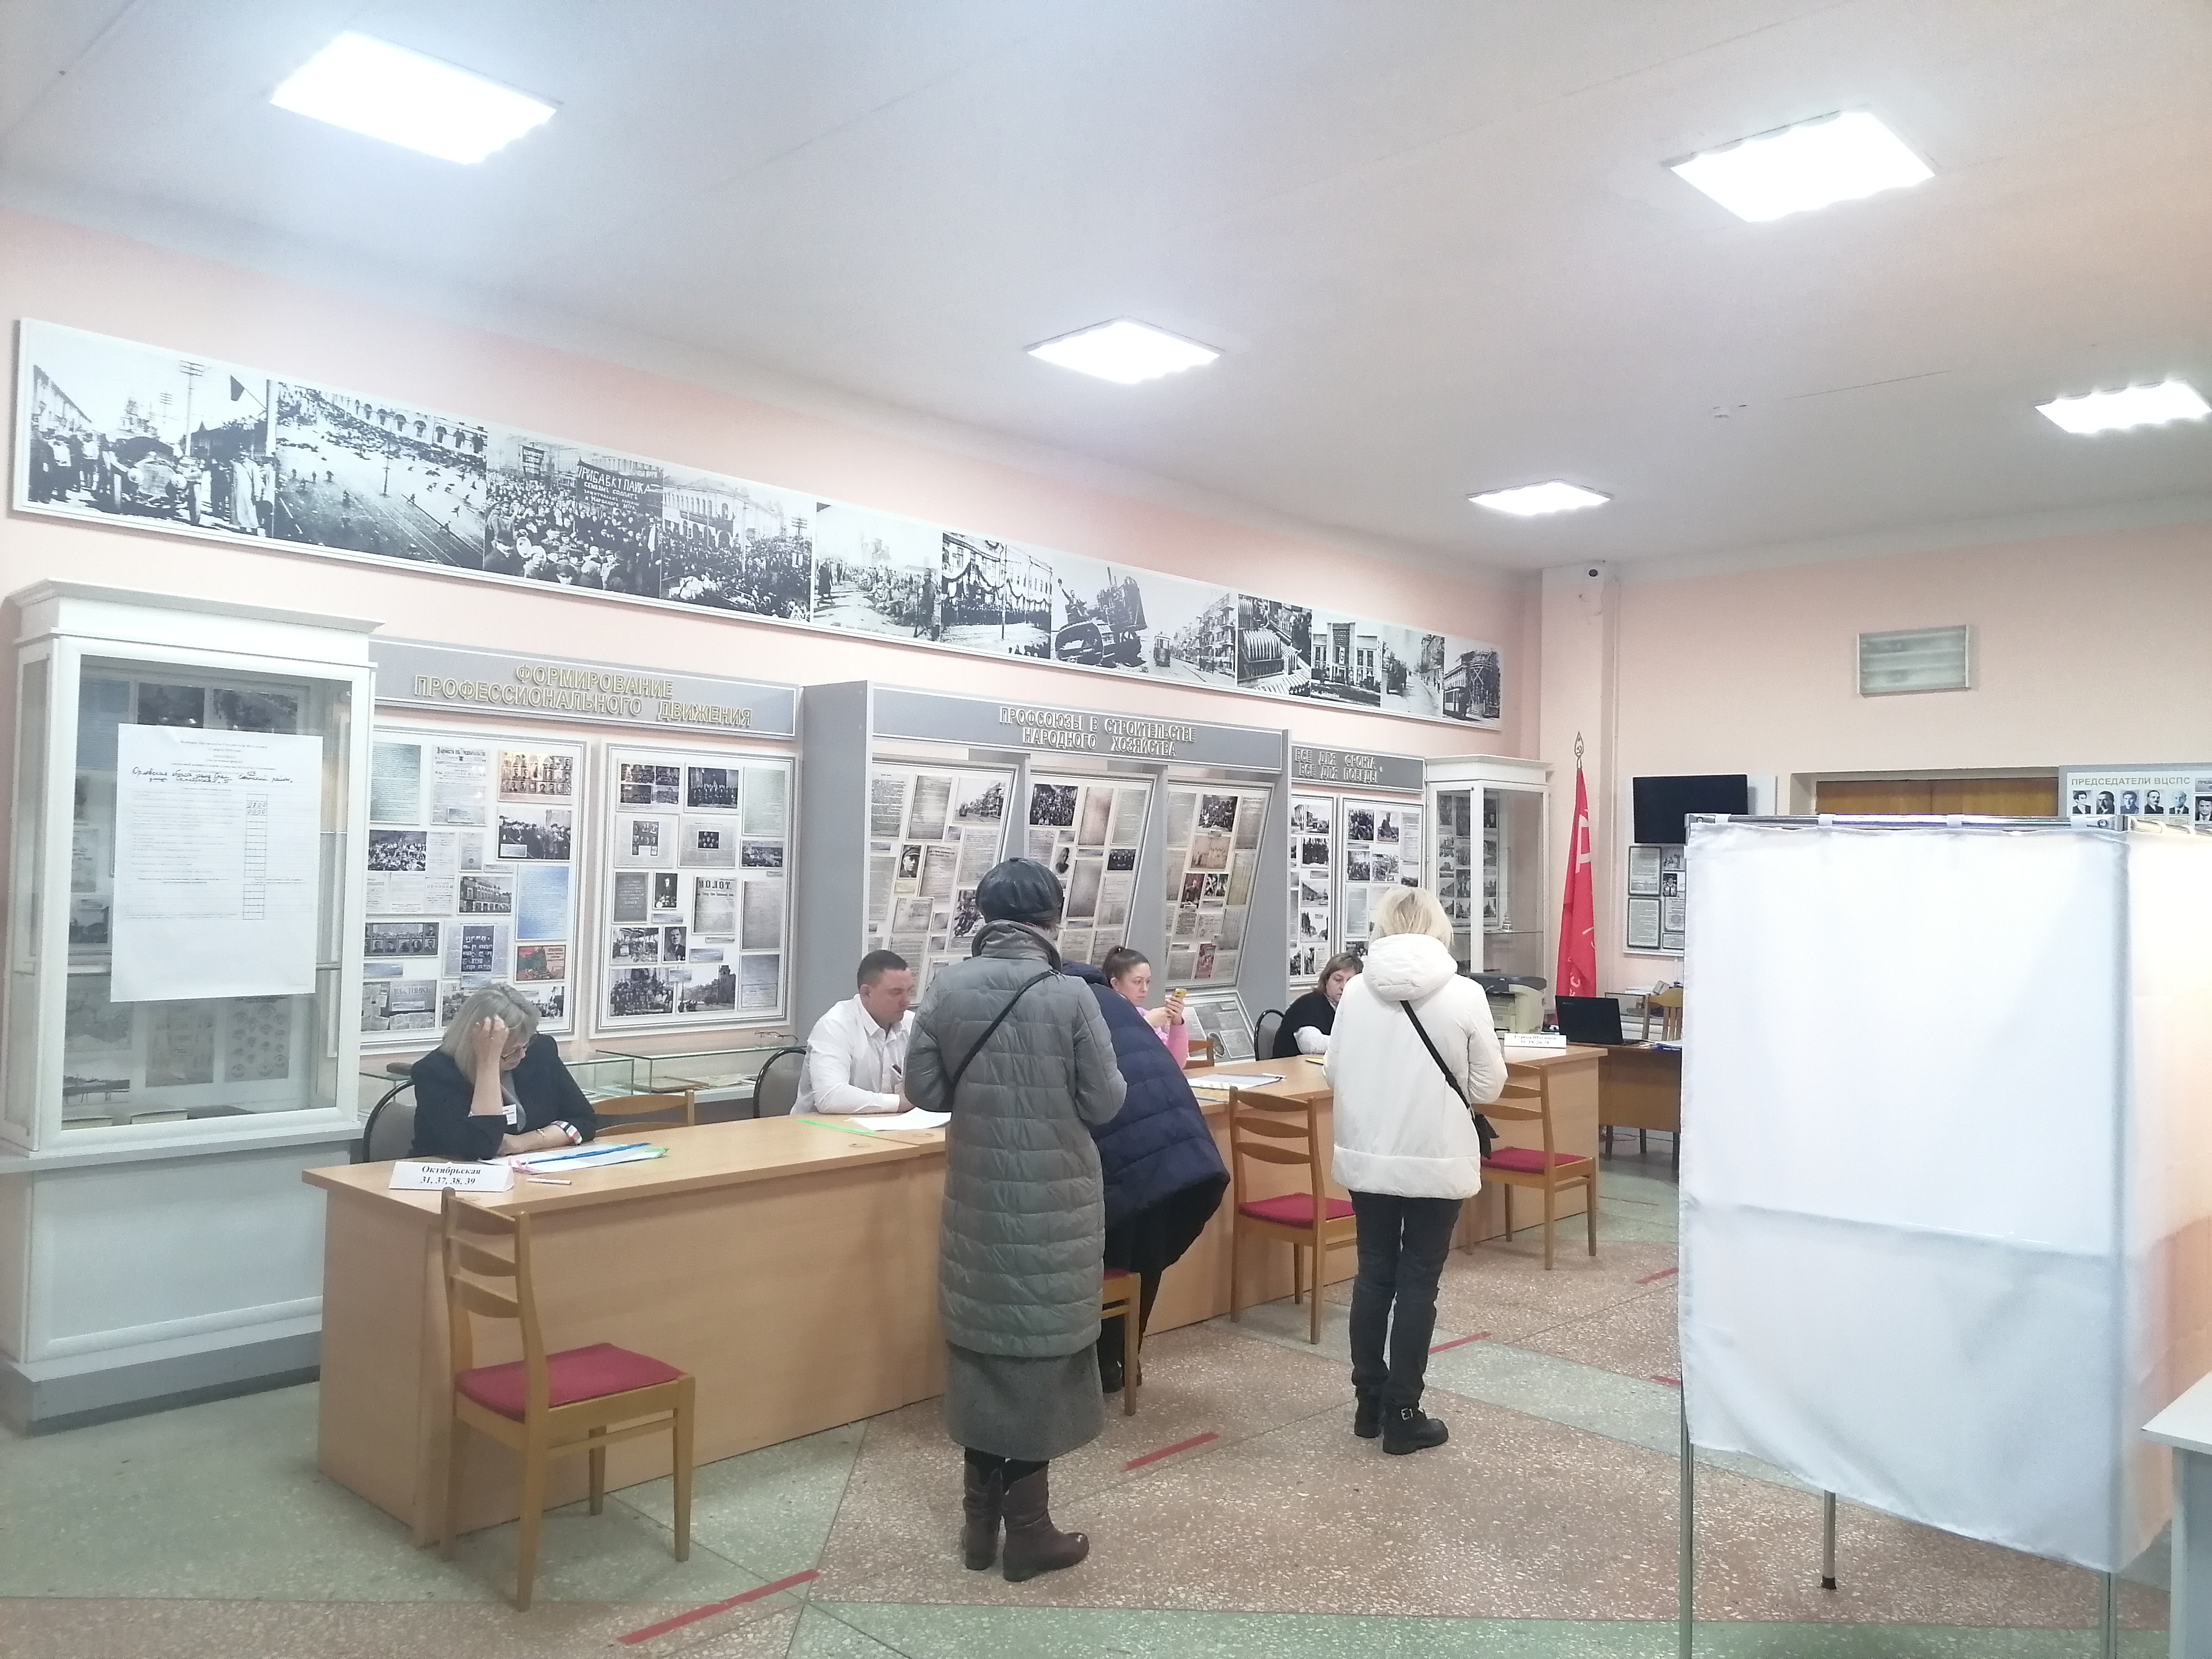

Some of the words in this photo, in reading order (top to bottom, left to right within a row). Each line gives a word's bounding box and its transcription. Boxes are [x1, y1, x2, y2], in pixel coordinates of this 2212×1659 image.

[516, 664, 673, 698] ФОРМИРОВАНИЕ
[414, 675, 643, 716] ПРОФЕССИОНАЛЬНОГО
[658, 699, 752, 726] ДВИЖЕНИЯ
[999, 707, 1083, 731] ПРОФСОЮЗЫ
[1089, 717, 1099, 732] В
[1104, 718, 1197, 742] СТРОИТЕЛЬСТВЕ
[1022, 727, 1097, 749] НАРОДНОГО
[1110, 736, 1177, 757] ХОЗЯЙСТВА
[1295, 748, 1312, 763] ВСЕ
[1318, 751, 1336, 766] ДЛЯ
[1299, 763, 1316, 777] ВСЕ
[1321, 765, 1338, 780] ДЛЯ
[1343, 767, 1378, 784] ПОБЕДЫ
[2072, 778, 2151, 786] ПРЕДСЕДАТЕЛИ
[422, 1166, 481, 1176] Октябрьская
